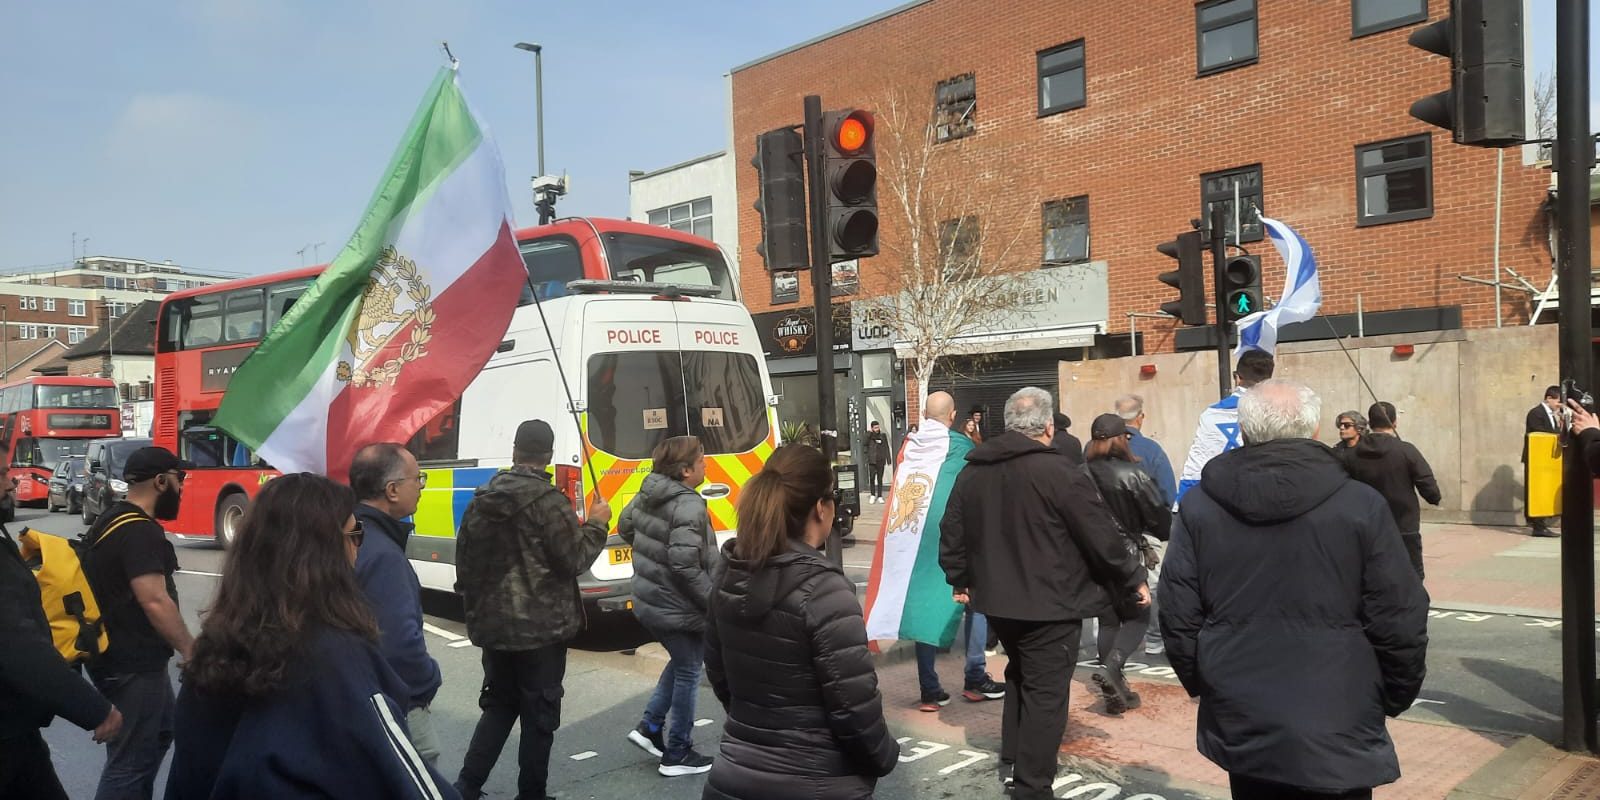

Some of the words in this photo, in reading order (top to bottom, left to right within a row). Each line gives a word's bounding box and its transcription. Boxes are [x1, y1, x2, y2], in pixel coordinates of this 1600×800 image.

[607, 329, 662, 344] POLICE
[695, 331, 739, 345] POLICE
[777, 324, 809, 338] WHISKY
